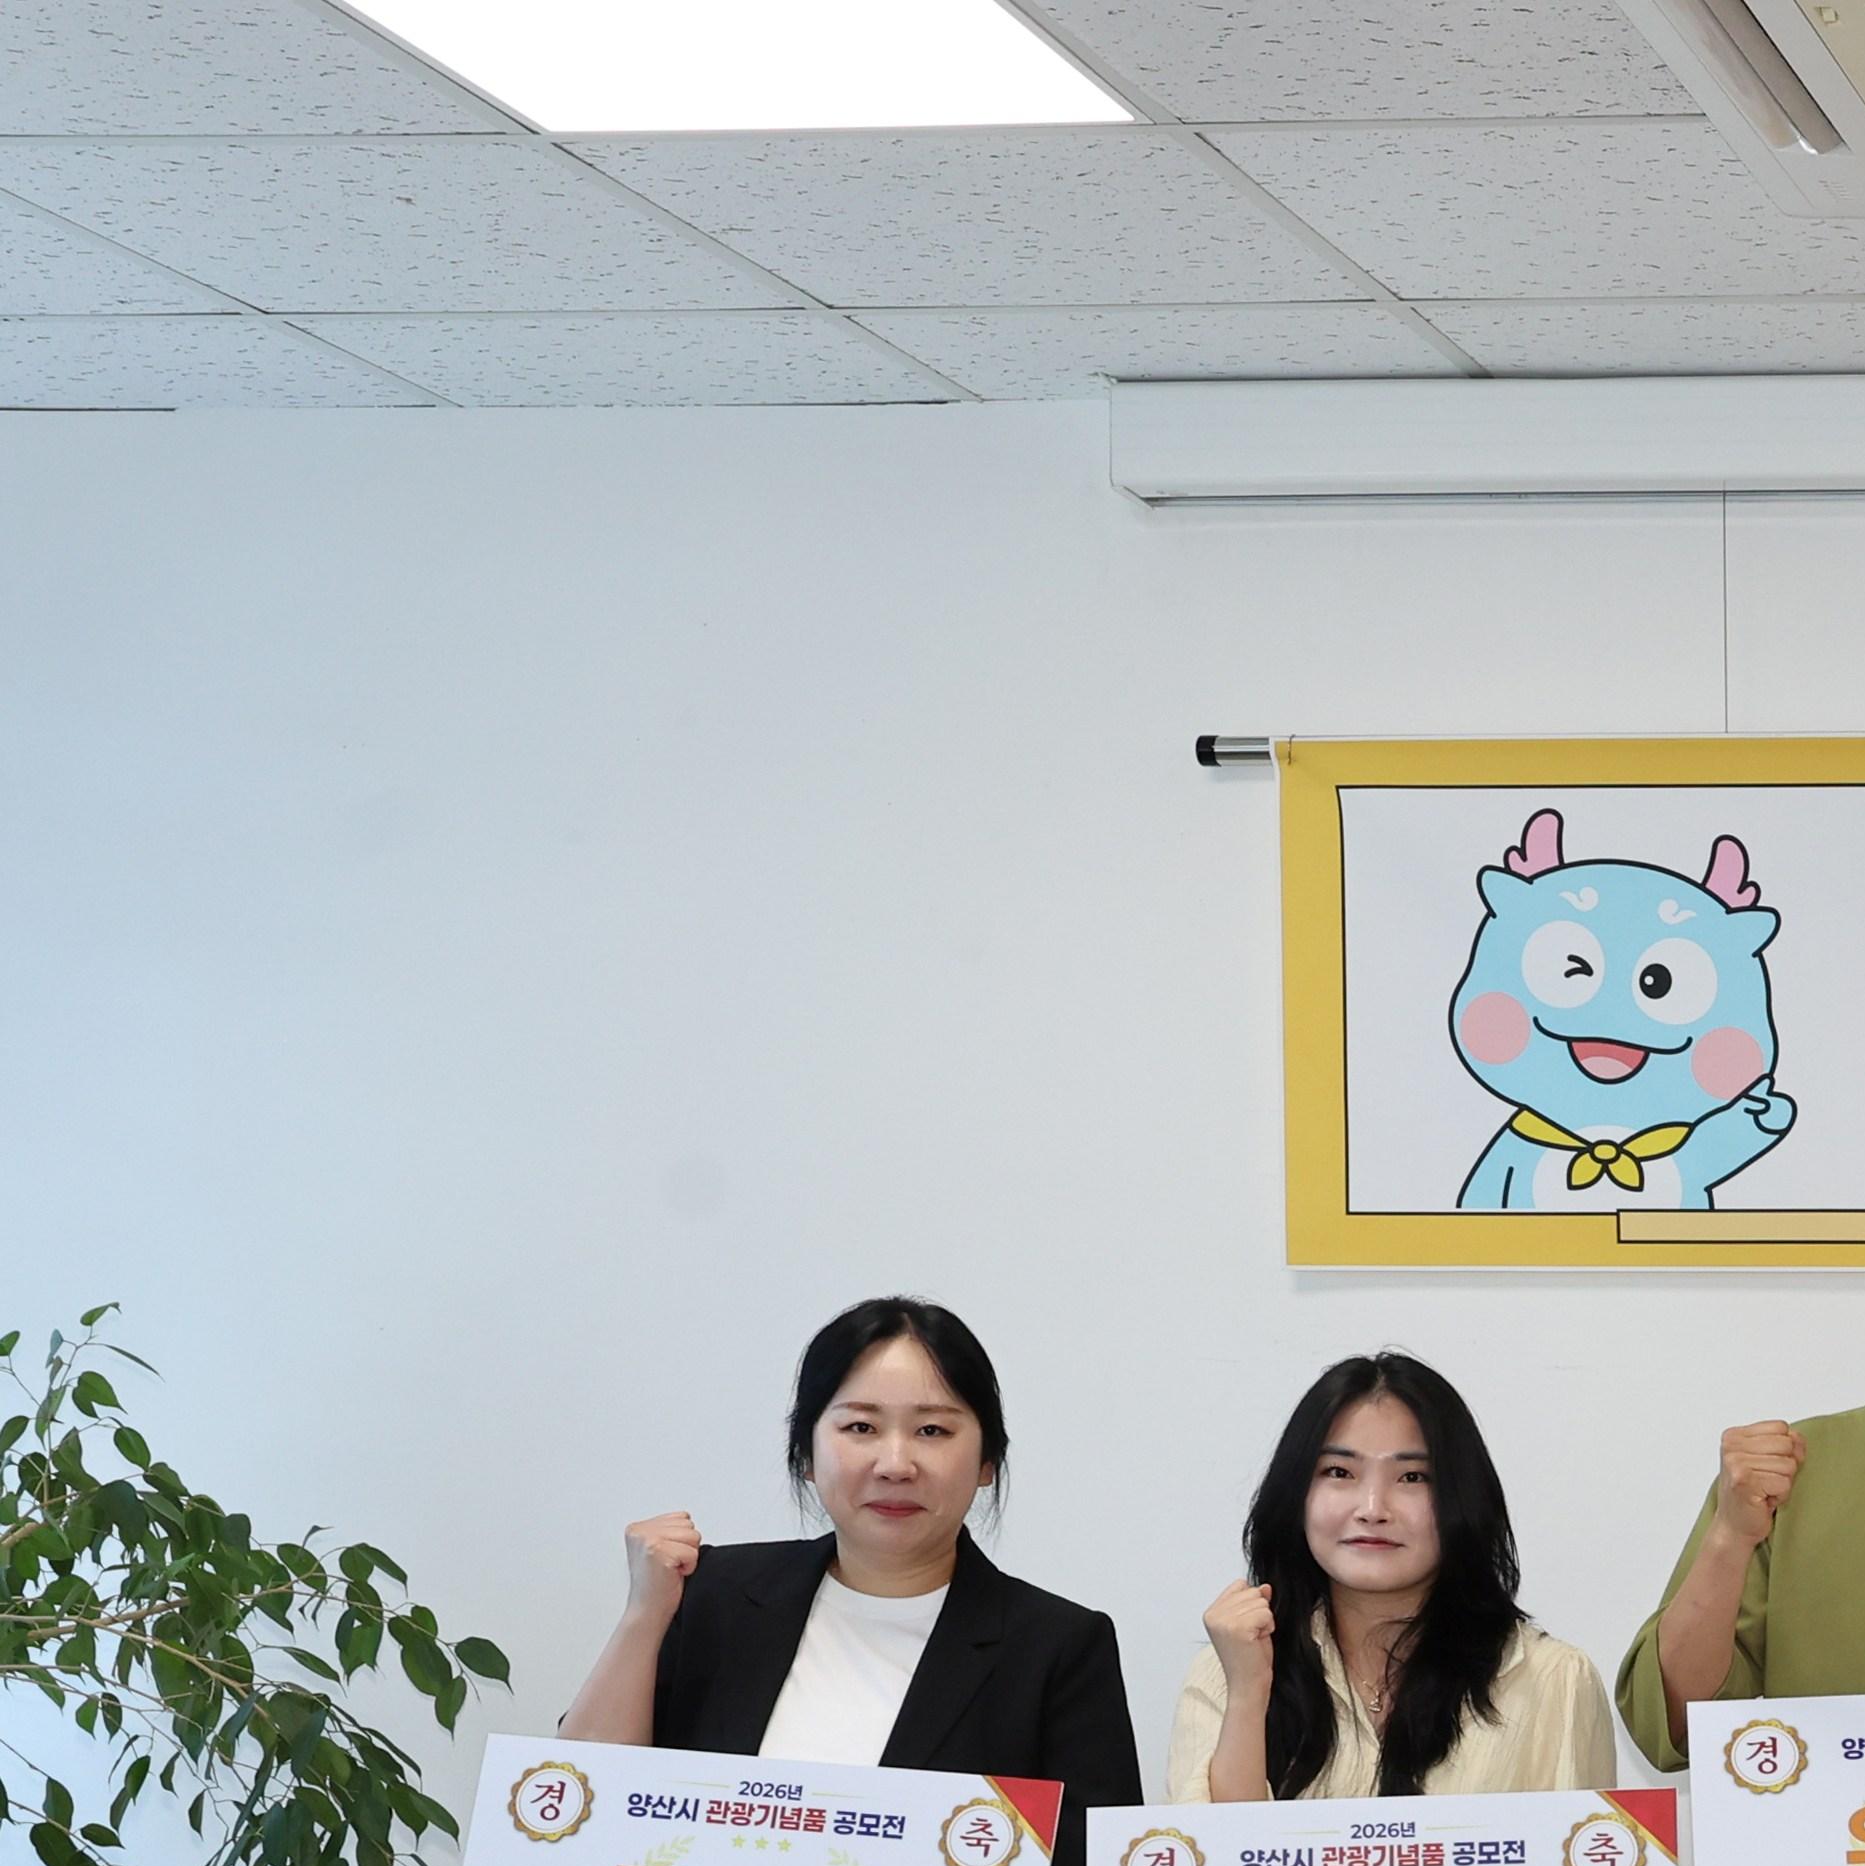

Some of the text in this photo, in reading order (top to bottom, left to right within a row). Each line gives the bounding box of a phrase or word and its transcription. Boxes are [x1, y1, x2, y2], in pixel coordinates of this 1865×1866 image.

[1747, 1737, 1777, 1774] 경
[531, 1781, 566, 1821] 경
[738, 1781, 803, 1801] 2026년
[627, 1793, 906, 1840] 양산시 관광기념품 공모전
[1351, 1822, 1415, 1839] 2026년
[960, 1818, 999, 1857] 축
[1452, 1840, 1525, 1866] 공모전
